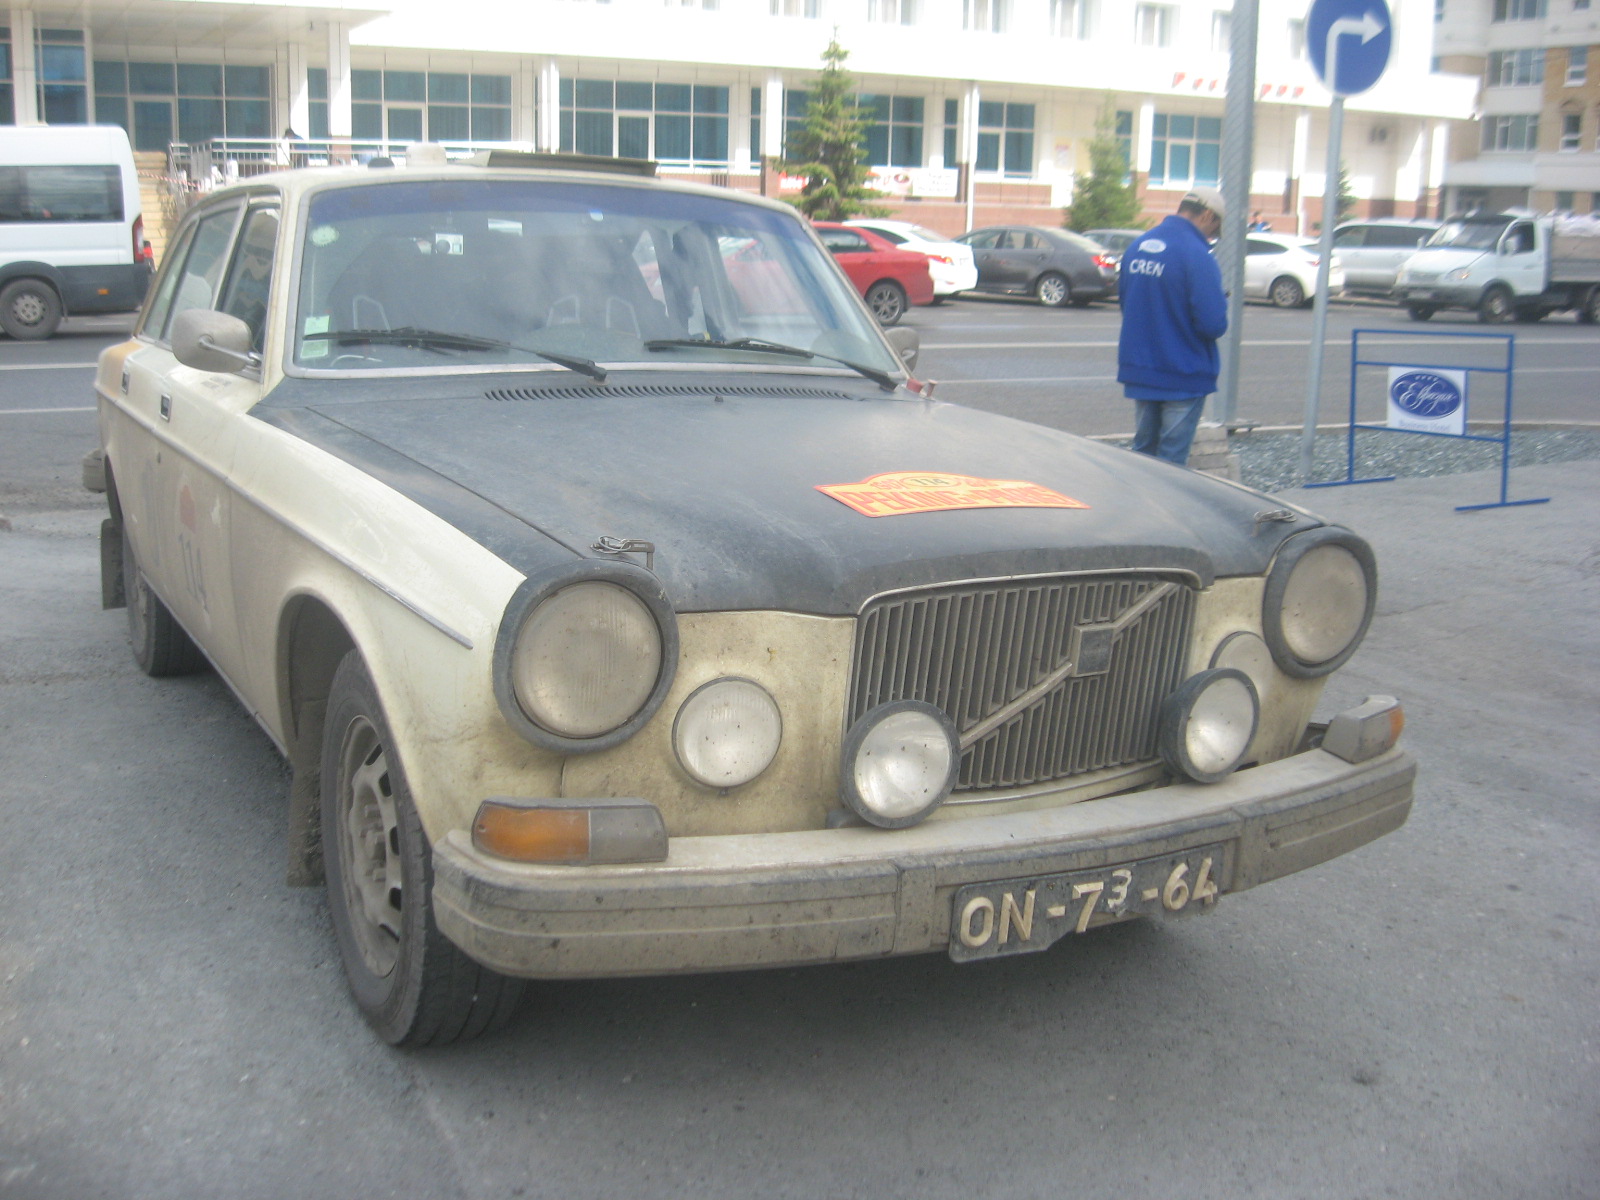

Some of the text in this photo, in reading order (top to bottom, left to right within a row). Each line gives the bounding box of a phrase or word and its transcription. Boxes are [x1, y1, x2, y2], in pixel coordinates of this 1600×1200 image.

[910, 478, 949, 486] 114
[842, 486, 1071, 512] PEKING PARIS
